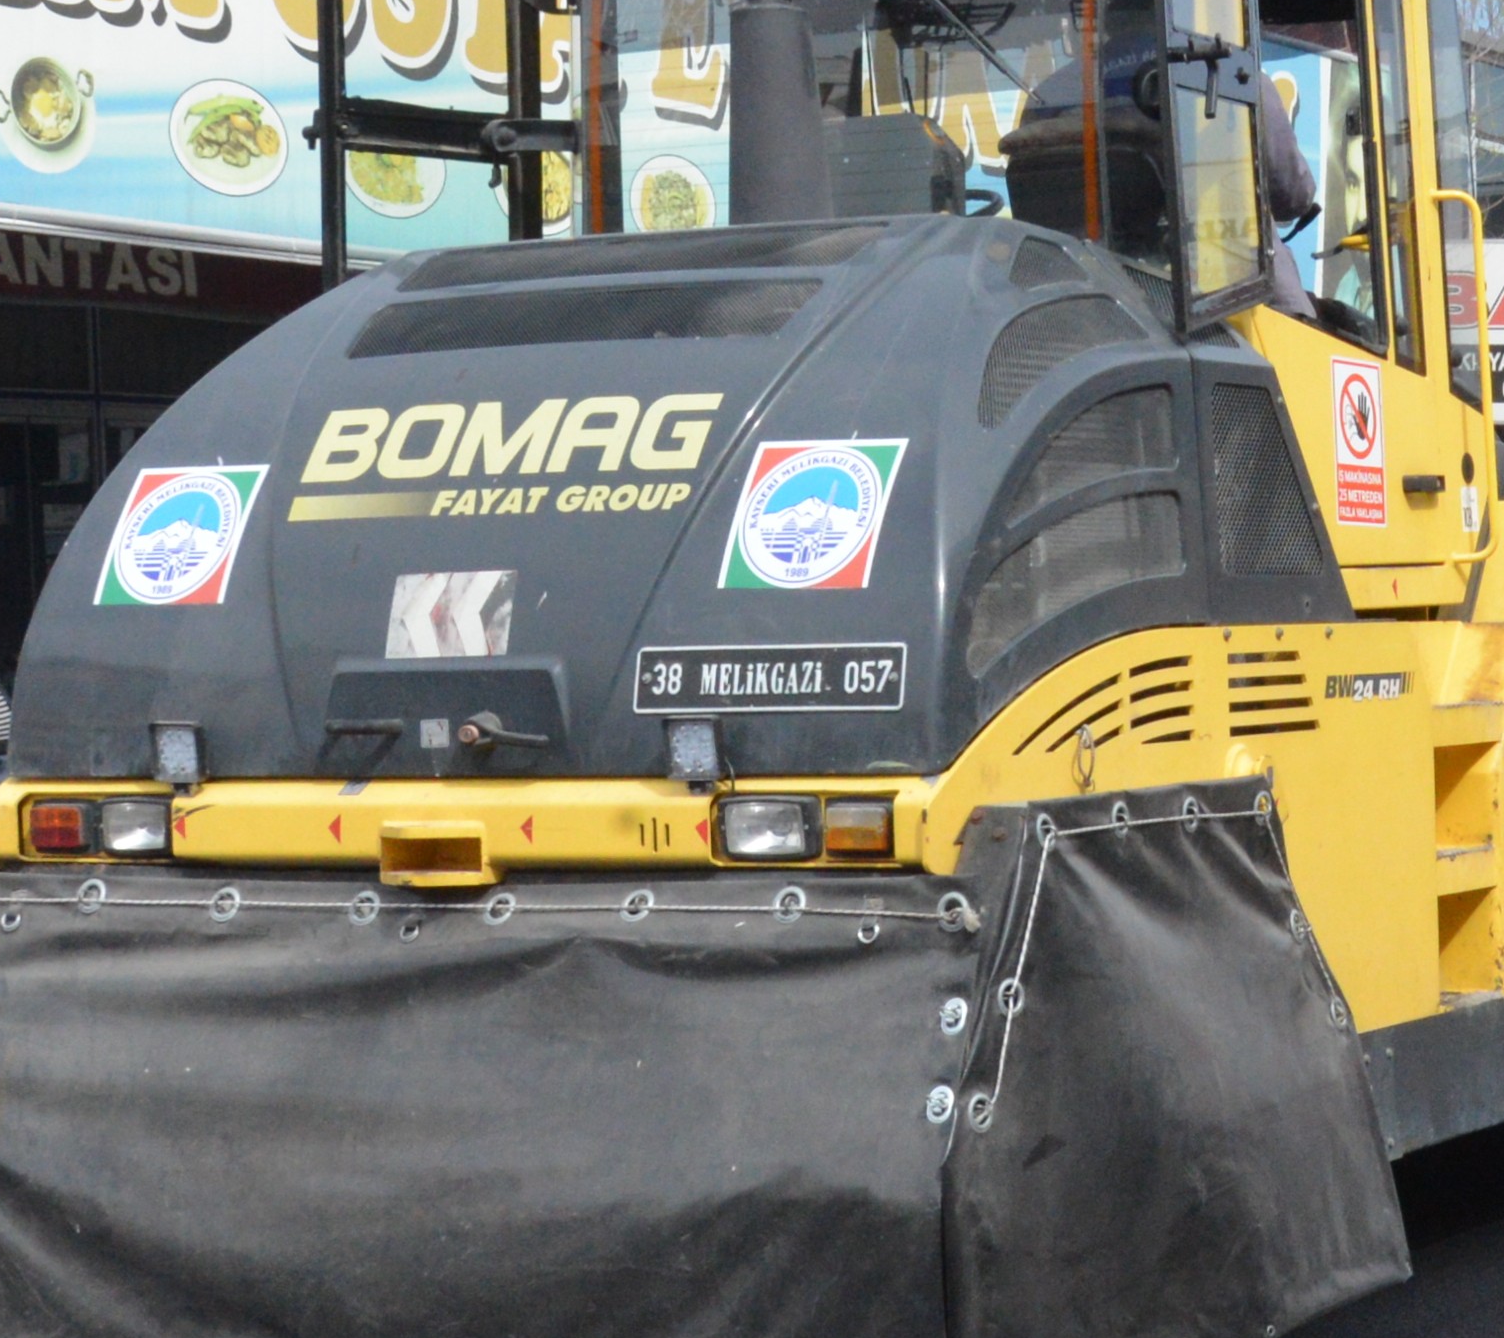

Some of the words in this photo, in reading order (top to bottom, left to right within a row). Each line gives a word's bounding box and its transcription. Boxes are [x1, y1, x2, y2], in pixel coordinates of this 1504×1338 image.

[300, 392, 725, 484] BOMAG
[429, 485, 548, 517] FAYAT
[556, 482, 692, 513] GROUP
[784, 567, 809, 578] 1989
[651, 662, 683, 695] 38
[843, 659, 894, 694] 057
